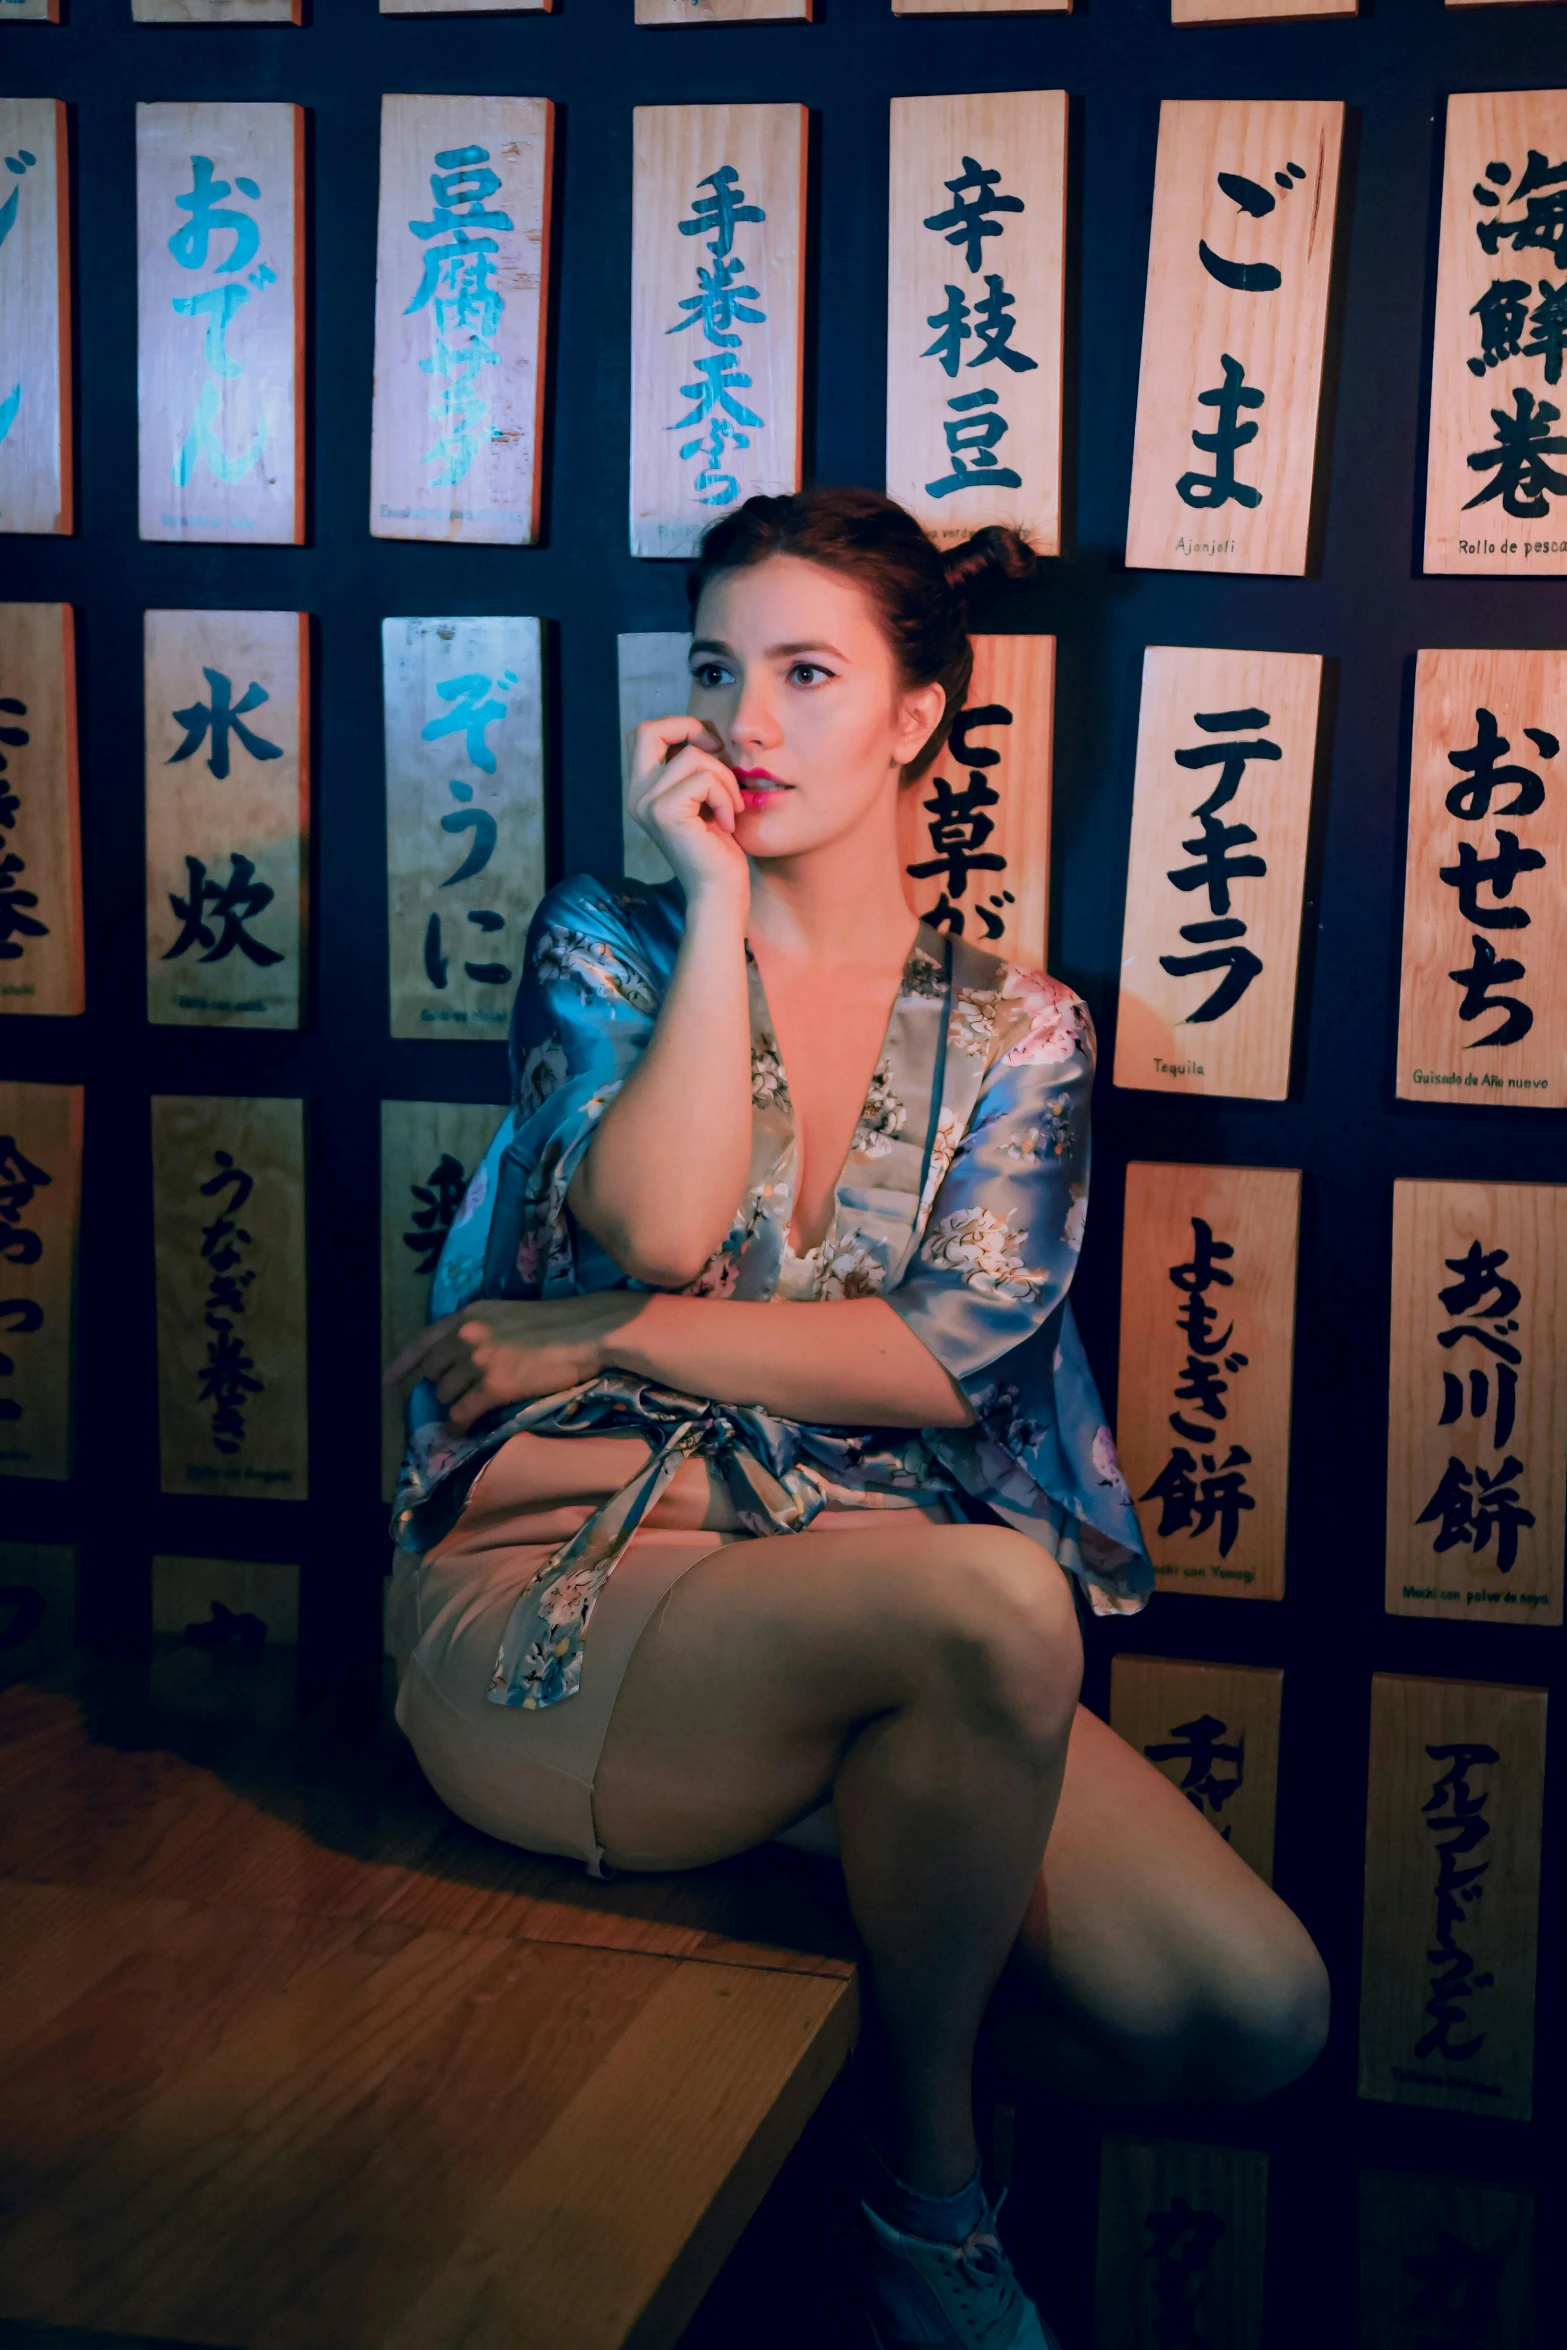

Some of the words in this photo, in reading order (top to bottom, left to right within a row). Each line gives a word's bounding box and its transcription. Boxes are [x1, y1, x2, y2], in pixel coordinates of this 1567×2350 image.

[168, 155, 277, 487] おでん
[921, 156, 1039, 499] 辛枝豆
[1176, 162, 1306, 509] ごま
[1458, 539, 1496, 555] Rollo
[1500, 539, 1518, 554] de
[163, 667, 285, 967] 水炊
[421, 671, 518, 989] ぞうに
[1159, 708, 1282, 1025] テキラ
[1440, 708, 1560, 1049] おせち
[1153, 1058, 1205, 1078] Tequila
[1412, 1069, 1462, 1086] Guisado
[1464, 1072, 1479, 1087] de
[1481, 1072, 1504, 1088] Año
[1507, 1077, 1549, 1089] nuevo
[1139, 1216, 1255, 1558] よもぎ餅
[1415, 1239, 1536, 1573] あべ川餅
[1440, 1588, 1461, 1600] con
